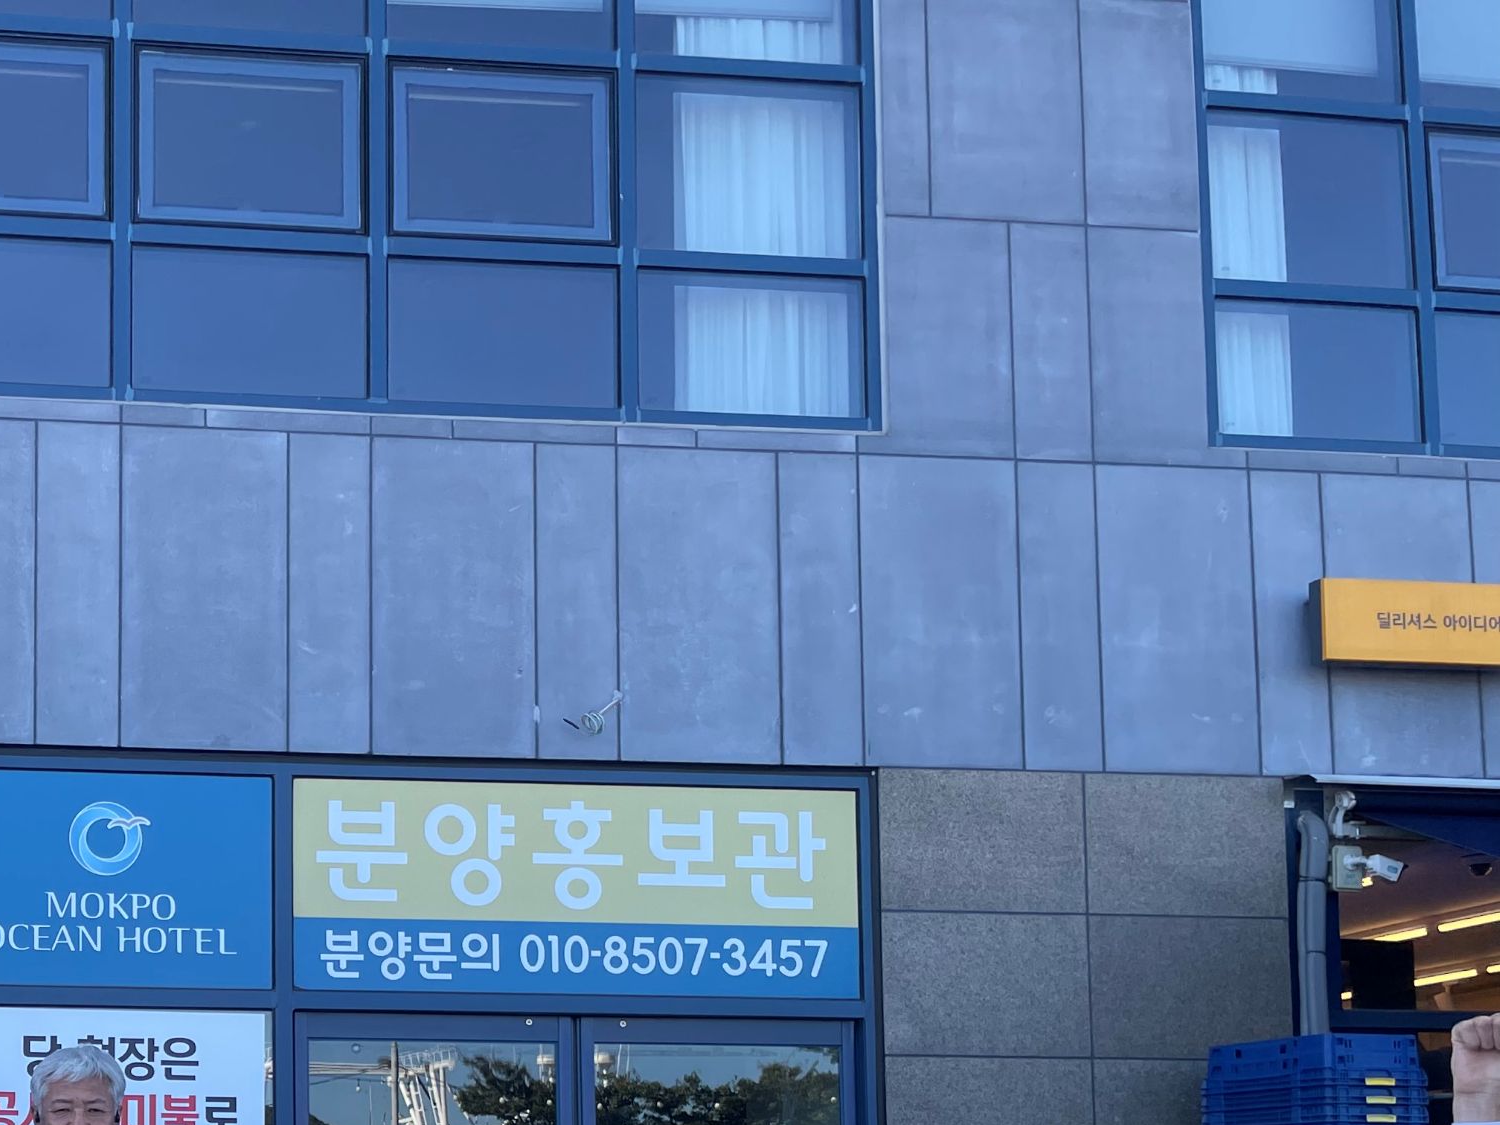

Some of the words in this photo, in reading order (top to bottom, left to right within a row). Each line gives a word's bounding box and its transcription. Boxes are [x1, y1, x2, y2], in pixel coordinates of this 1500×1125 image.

[1376, 612, 1438, 631] 딜리셔스
[316, 800, 827, 910] 분양홍보관
[45, 891, 177, 921] MOKPO
[117, 925, 238, 956] HOTEL
[320, 929, 500, 981] 분양문의
[518, 934, 829, 978] 010-8507-3457
